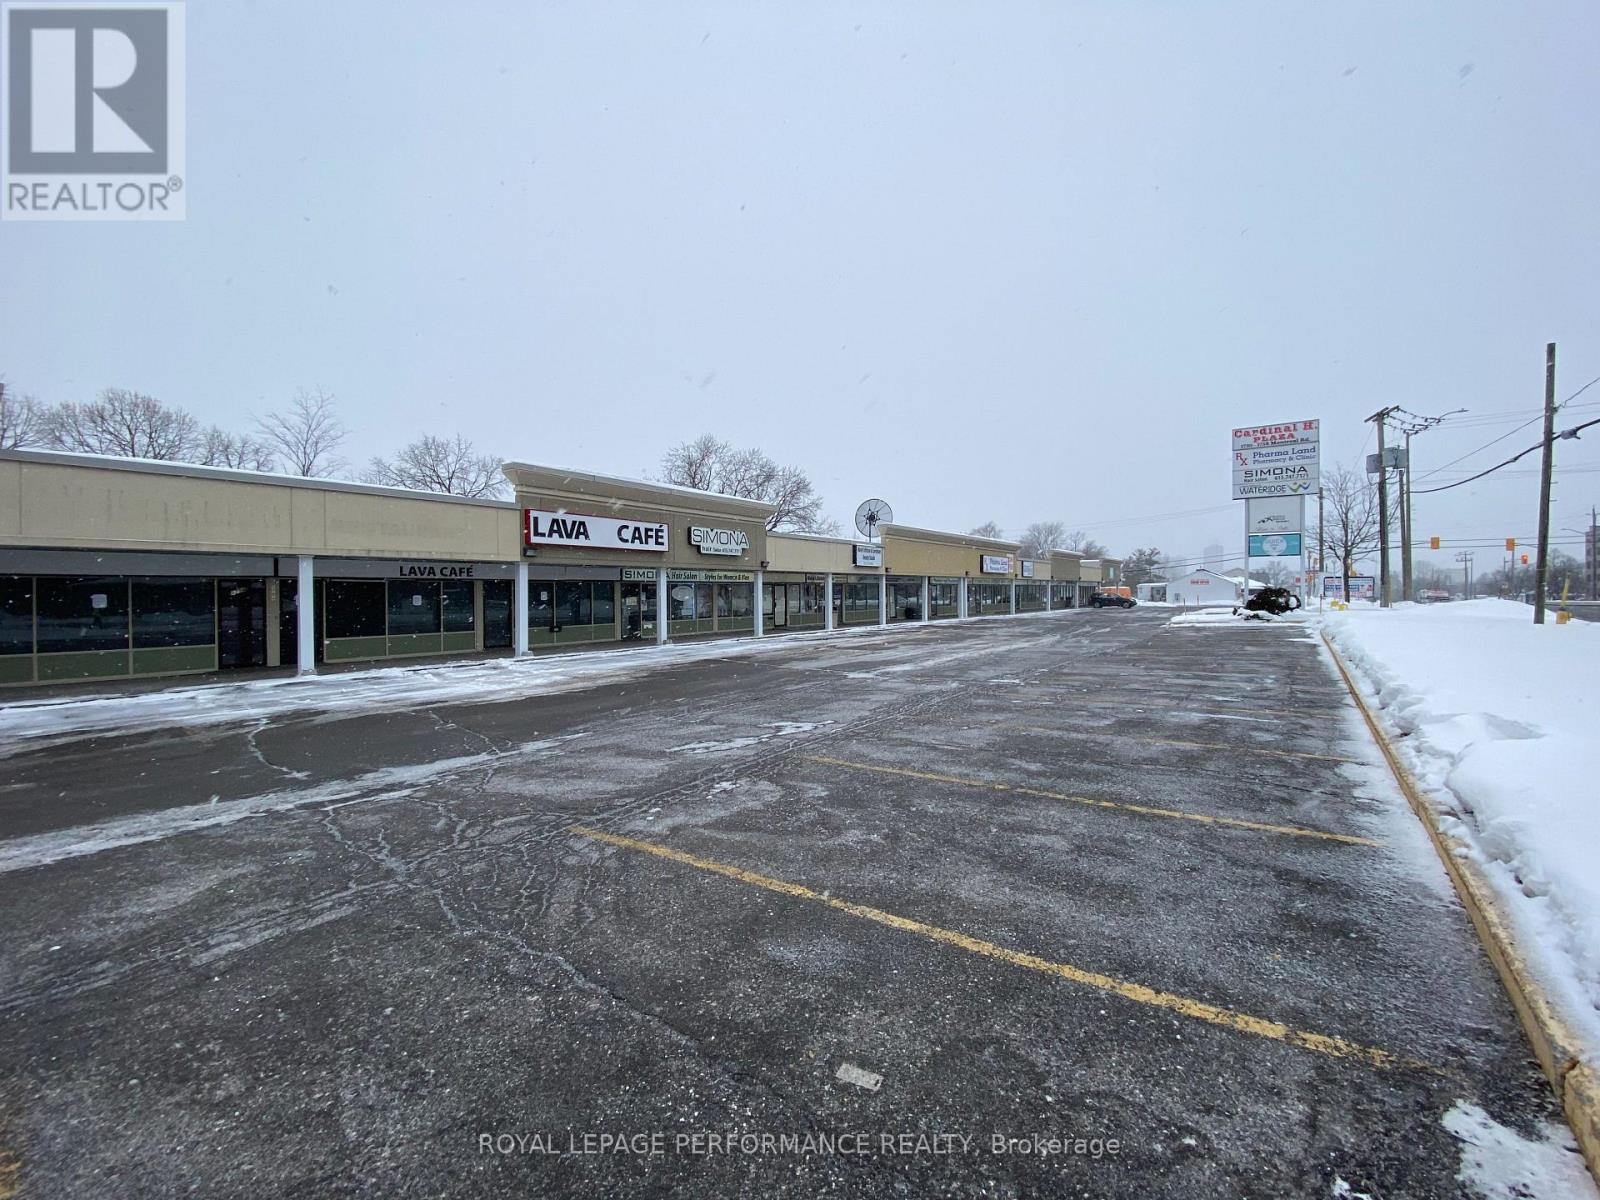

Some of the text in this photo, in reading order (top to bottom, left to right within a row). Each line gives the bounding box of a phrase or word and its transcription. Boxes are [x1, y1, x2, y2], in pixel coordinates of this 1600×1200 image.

[1234, 424, 1298, 438] Cardinal
[1253, 432, 1295, 443] PLAZA
[1253, 446, 1316, 459] Pharma Land
[1252, 457, 1287, 465] Pharmacy
[1244, 466, 1308, 478] SIMONA
[532, 516, 665, 546] LAVA CAFÉ
[693, 528, 748, 546] SIMONA
[399, 565, 474, 577] LAVA CAFÉ
[624, 570, 671, 579] SIMOA
[683, 571, 698, 580] Salon
